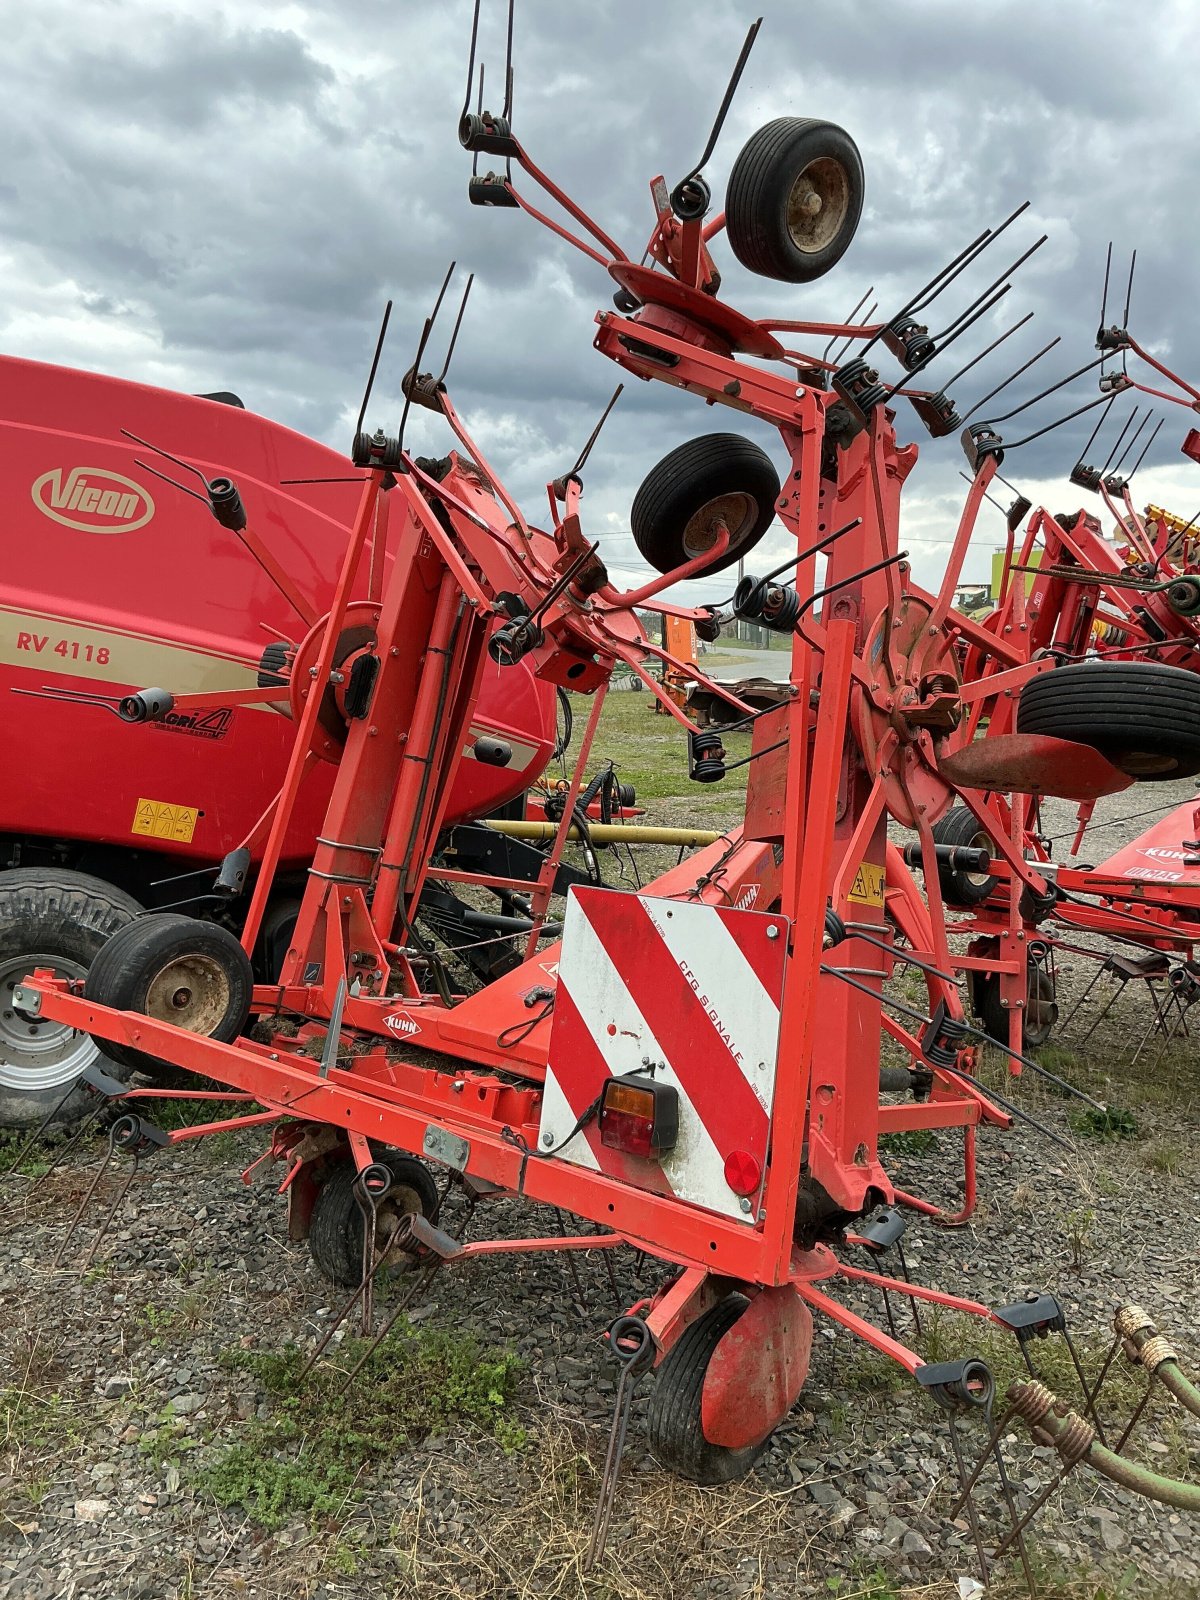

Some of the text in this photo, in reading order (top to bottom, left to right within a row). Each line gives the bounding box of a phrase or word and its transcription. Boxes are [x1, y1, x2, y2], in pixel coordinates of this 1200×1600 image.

[50, 467, 140, 519] Vicon
[17, 632, 110, 665] RV 4118
[679, 960, 700, 991] CFG
[387, 1015, 417, 1034] KUHN
